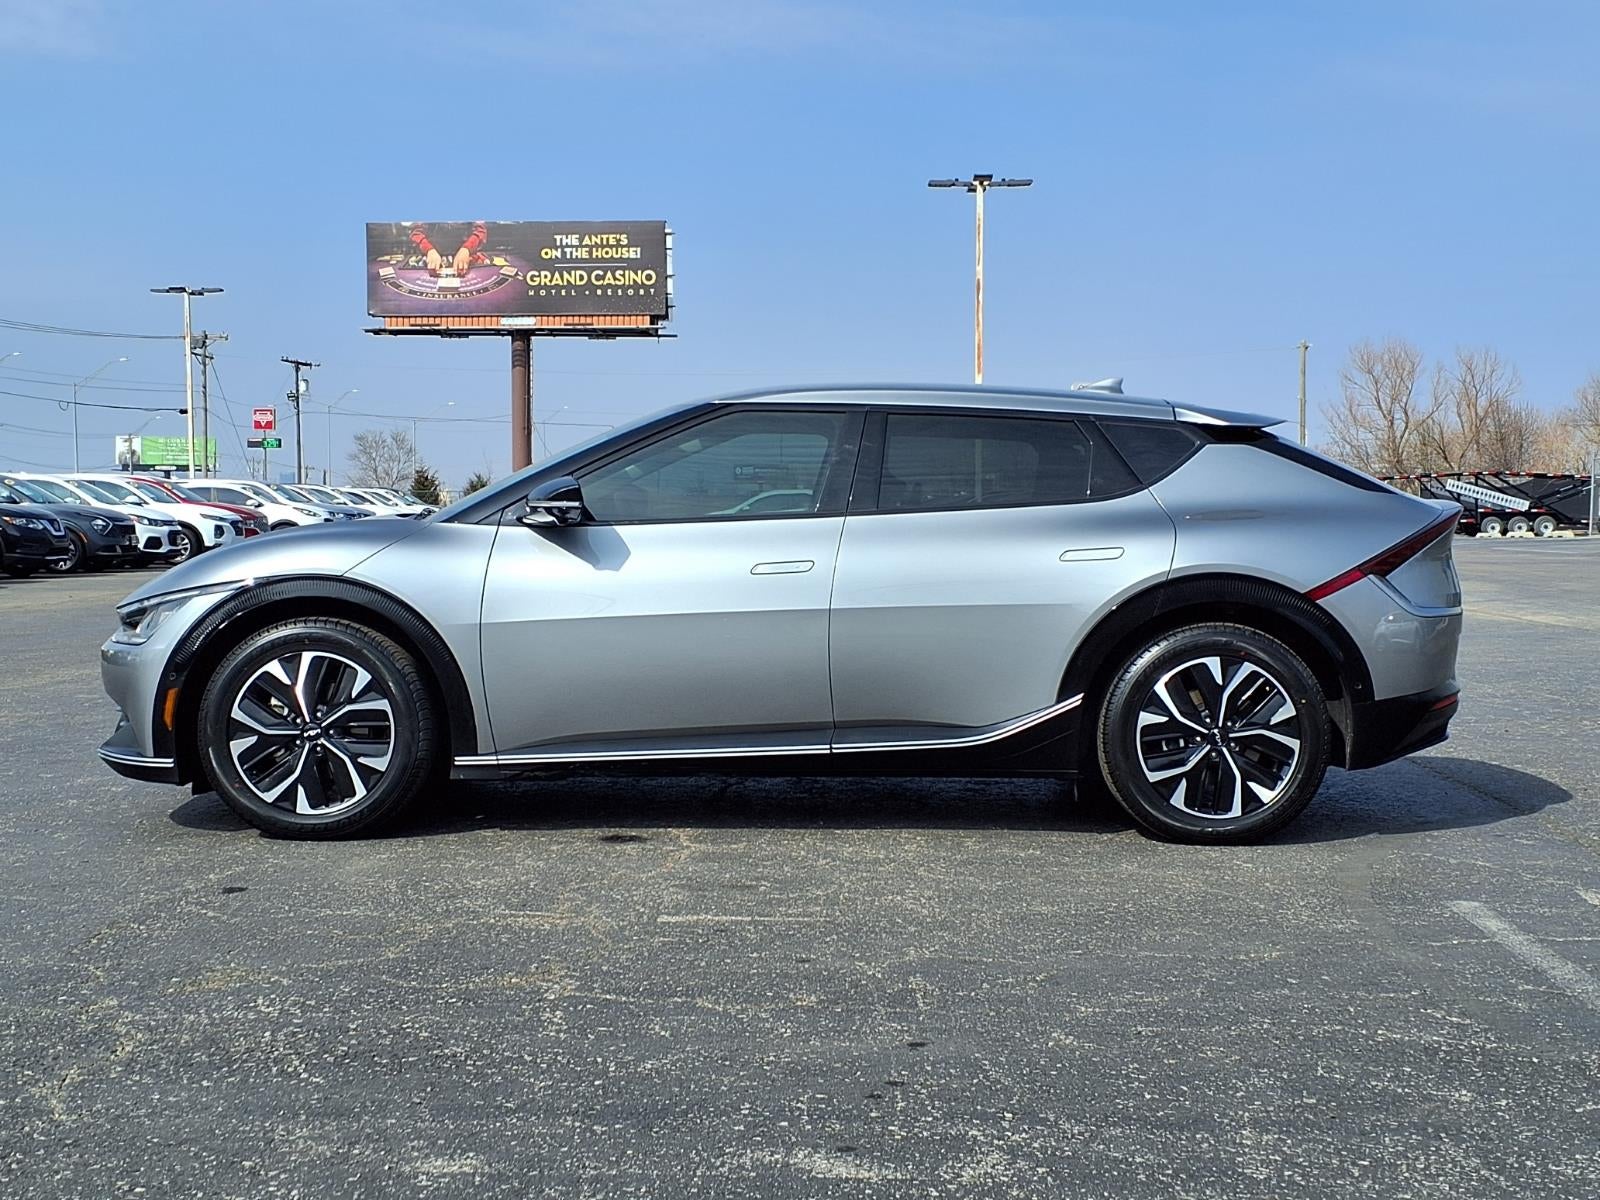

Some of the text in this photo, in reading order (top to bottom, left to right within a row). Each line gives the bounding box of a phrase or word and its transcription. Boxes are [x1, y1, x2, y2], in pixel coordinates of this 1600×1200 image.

[554, 234, 628, 246] THE ANTE'S
[540, 247, 641, 259] ON THE HOUSE!
[526, 269, 657, 286] GRAND CASINO
[596, 288, 655, 296] RESORT
